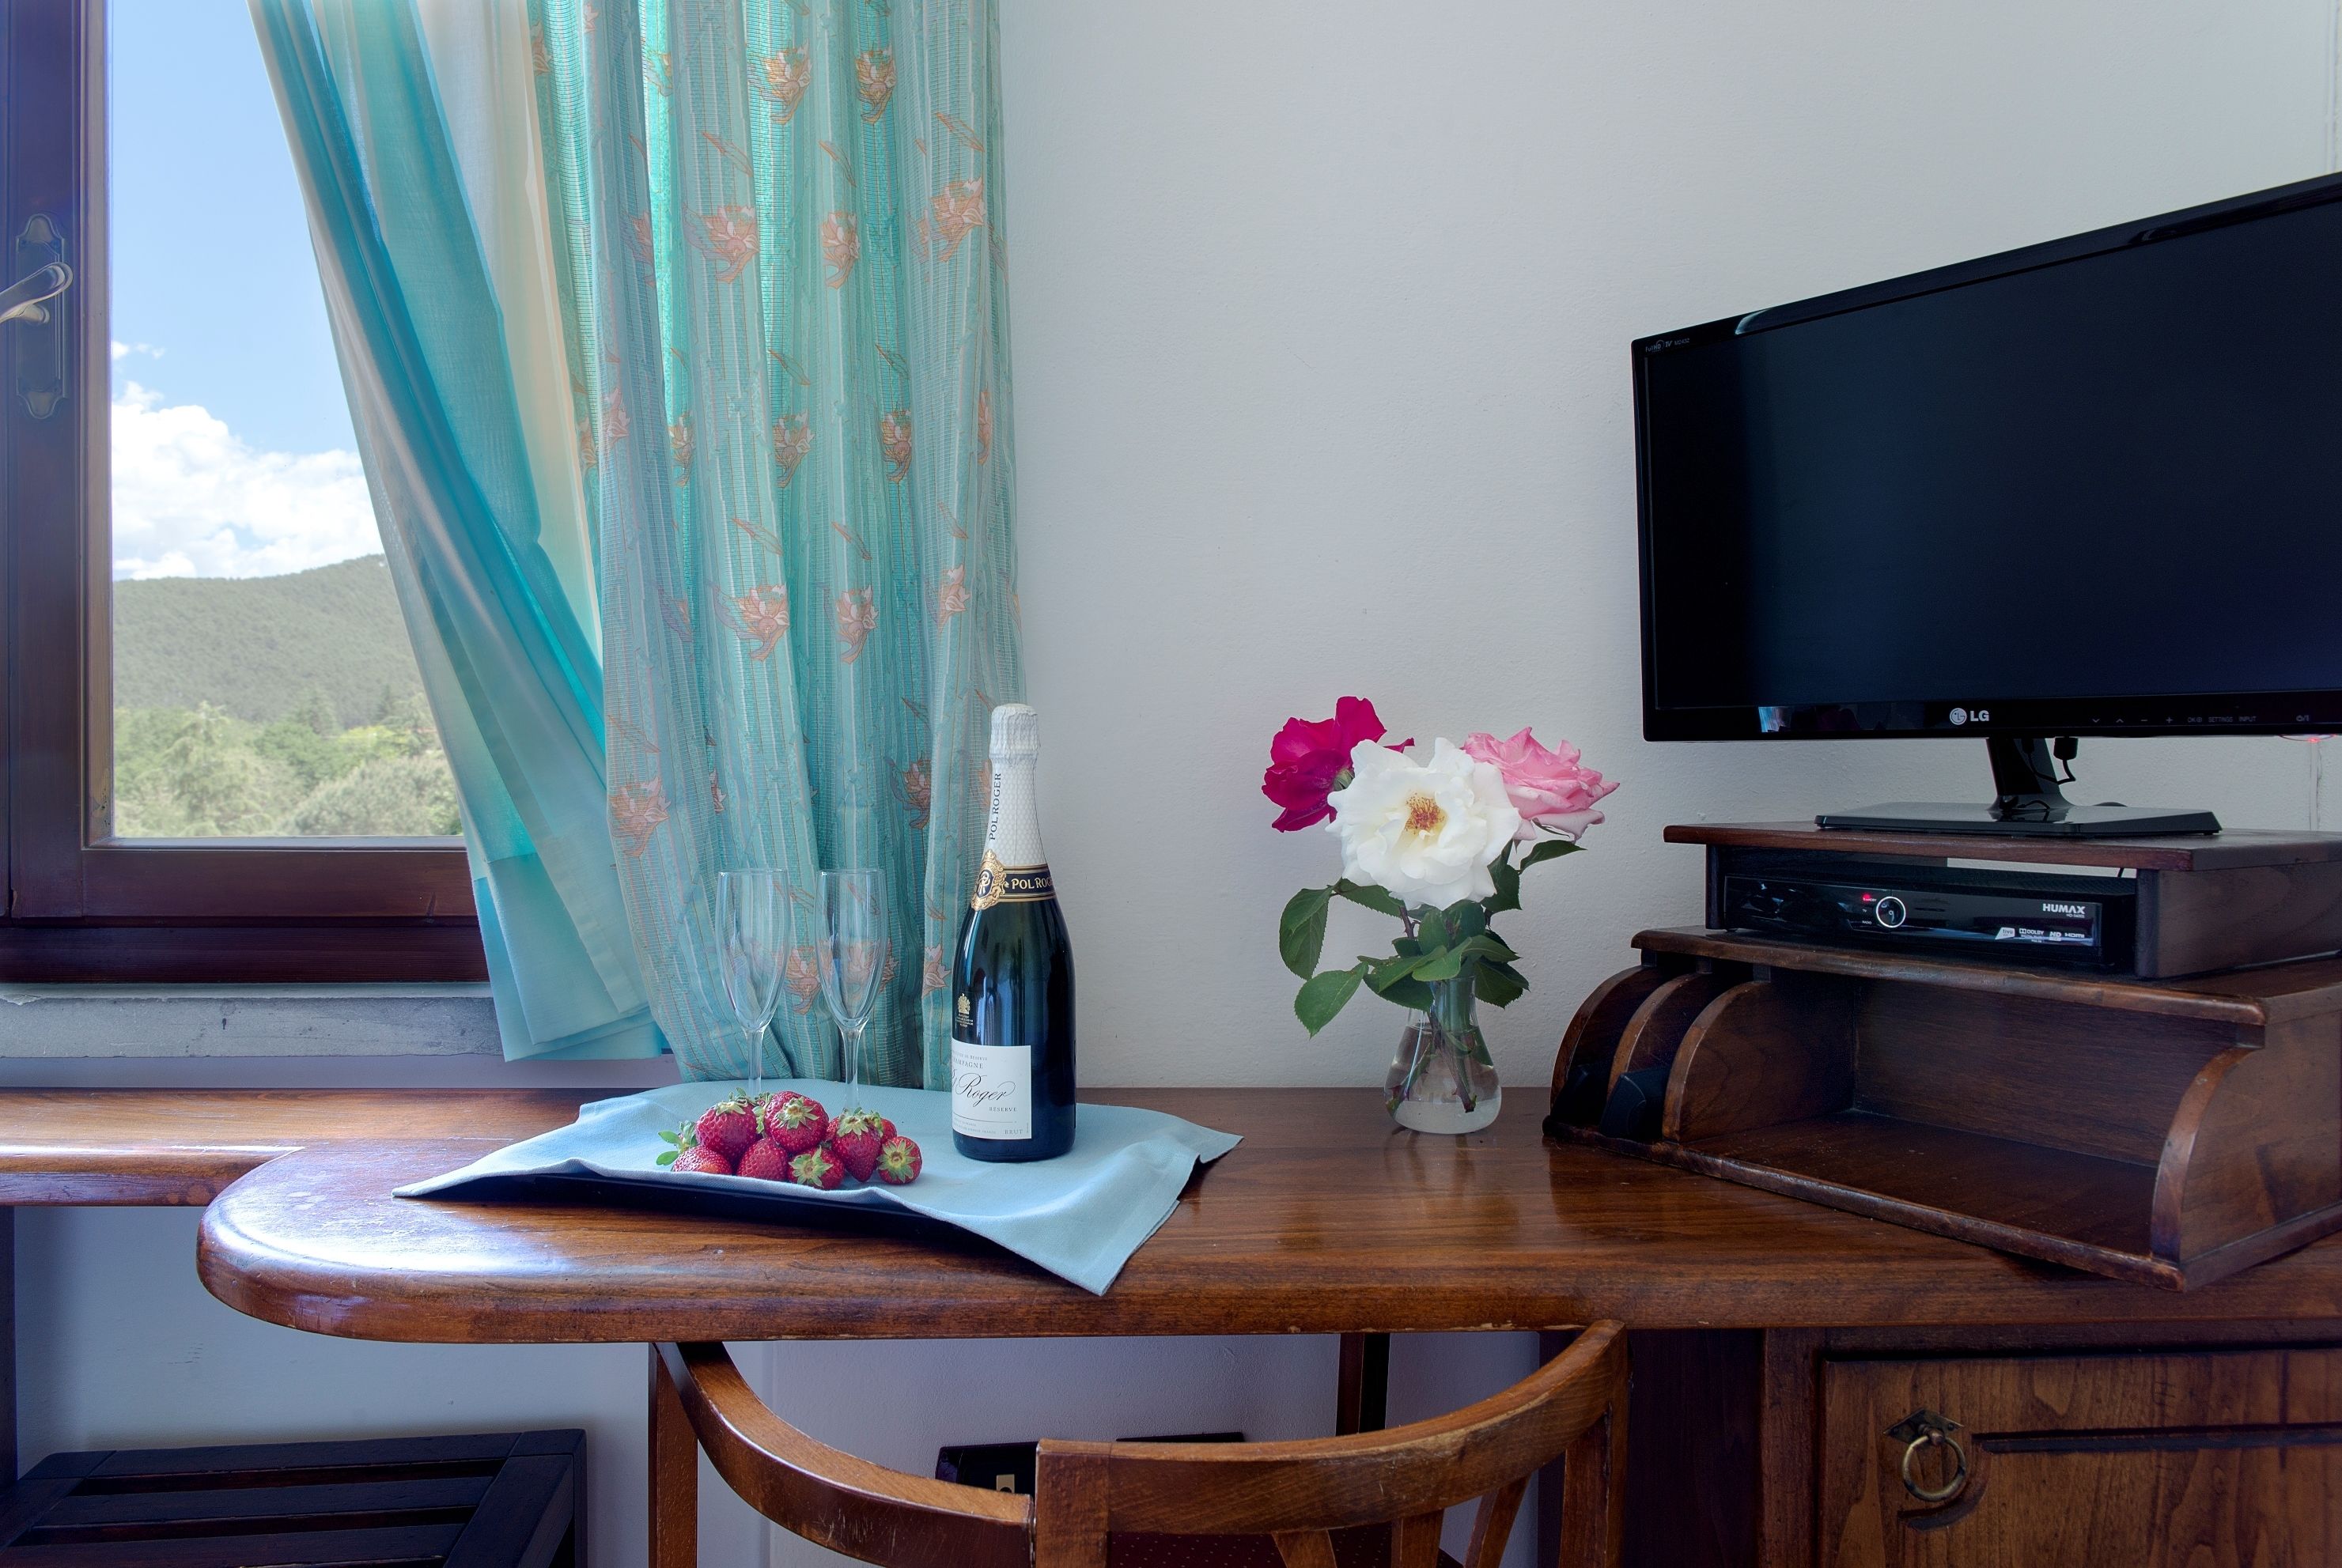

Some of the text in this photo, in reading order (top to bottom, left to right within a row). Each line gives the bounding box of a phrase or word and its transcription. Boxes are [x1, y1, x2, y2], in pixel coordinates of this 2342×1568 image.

[1970, 710, 1990, 722] LG
[989, 773, 1001, 841] POL ROGER
[1011, 878, 1035, 890] POL
[2042, 903, 2086, 915] HUMAX
[955, 1072, 1016, 1107] Roger
